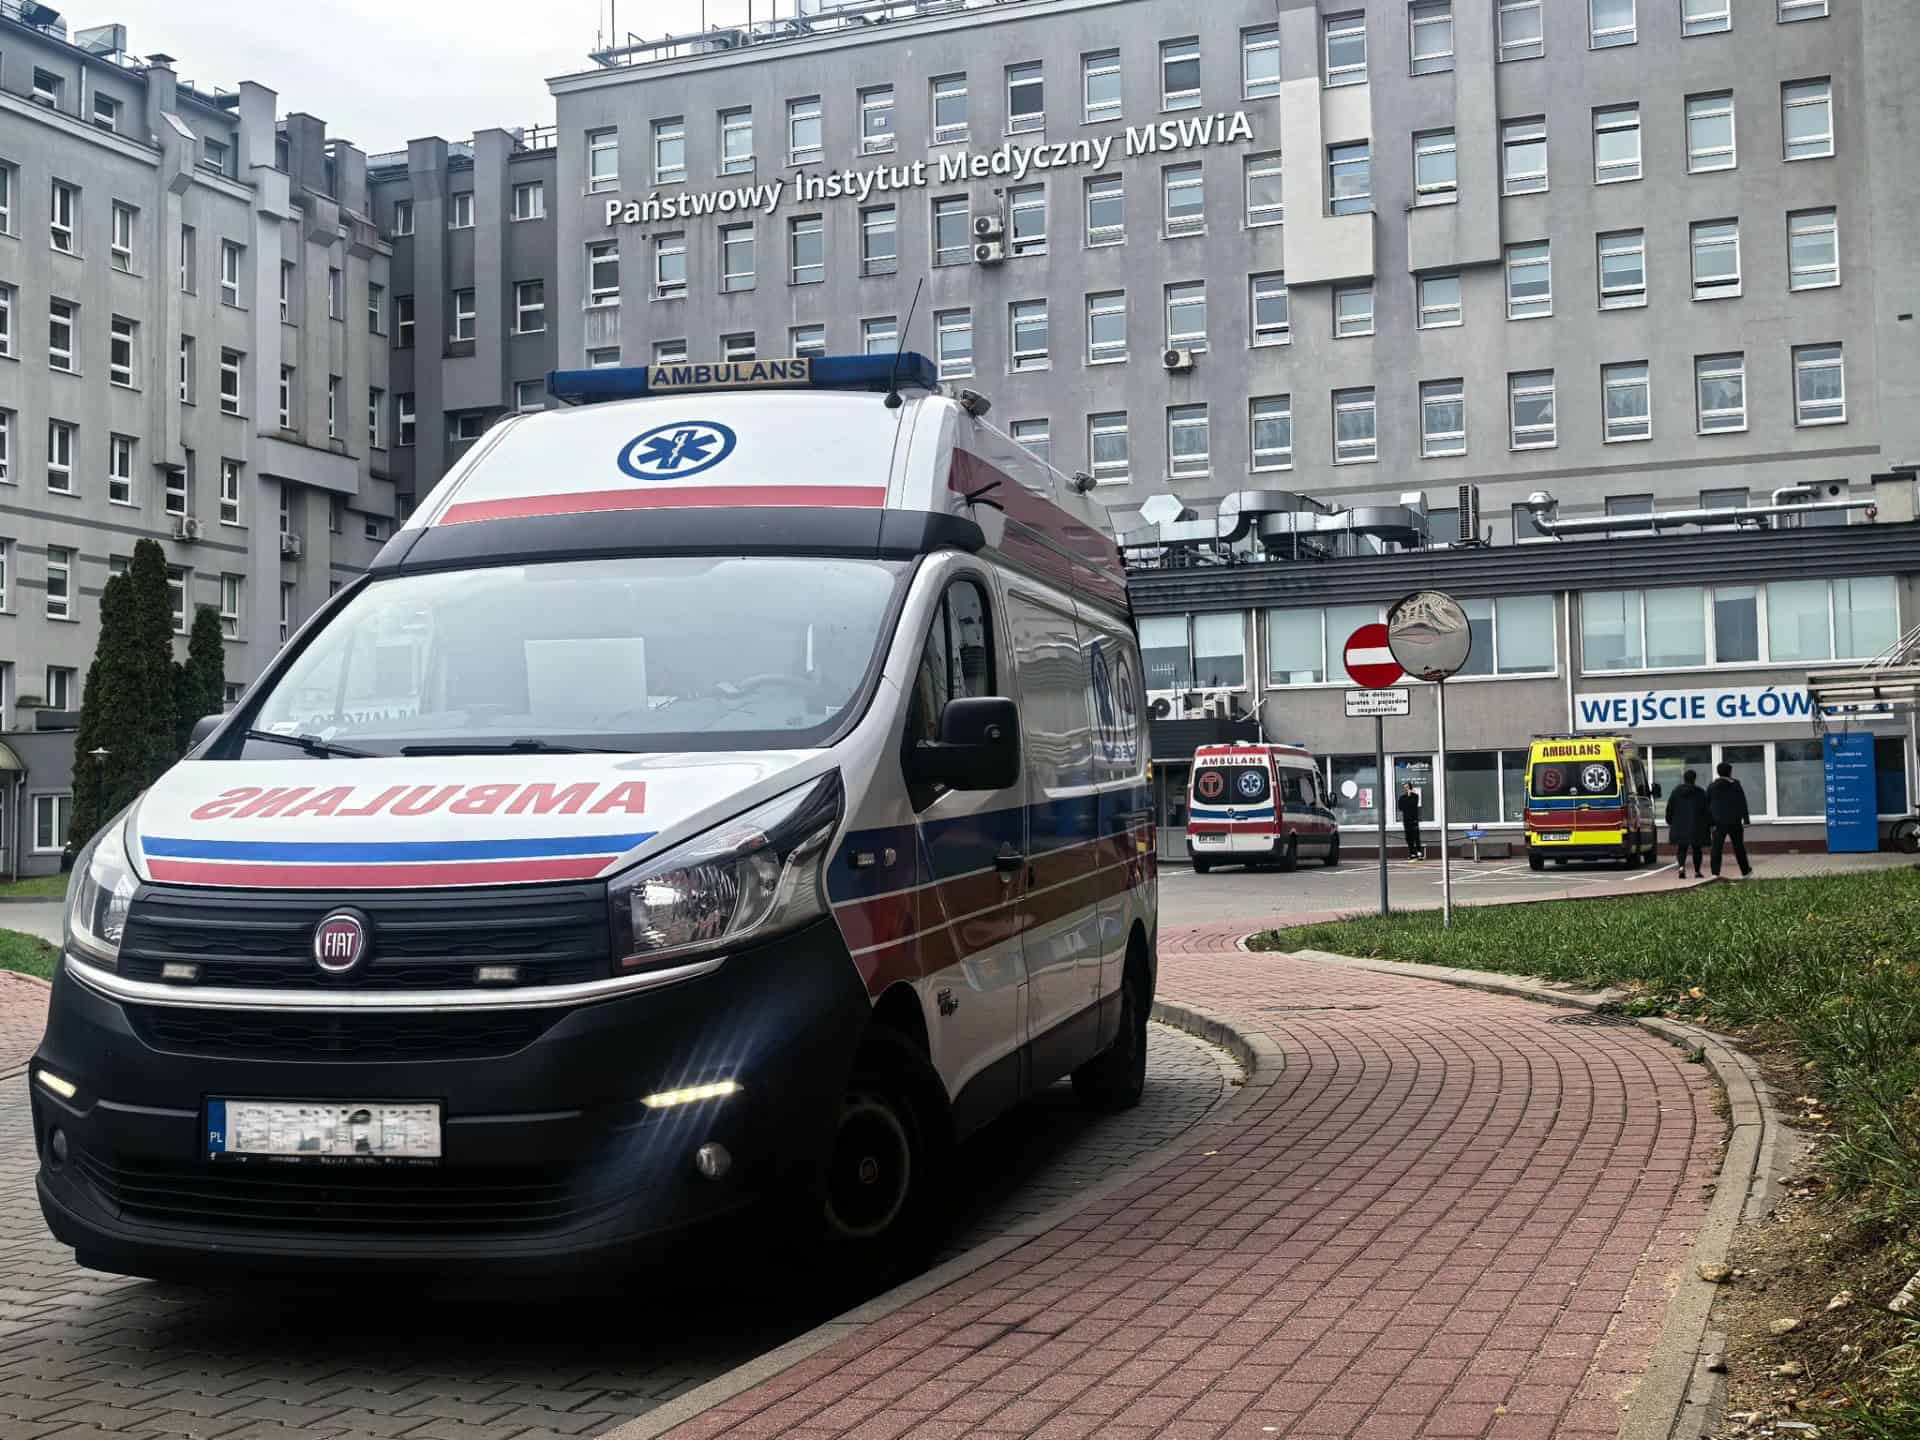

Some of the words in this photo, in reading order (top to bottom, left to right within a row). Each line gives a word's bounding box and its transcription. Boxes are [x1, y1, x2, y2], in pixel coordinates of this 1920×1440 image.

[605, 180, 783, 227] Państwowy
[795, 161, 927, 204] Instytut
[938, 134, 1112, 184] Medyczny
[1125, 110, 1254, 157] MSWiA
[651, 359, 806, 386] AMBULANS
[1581, 691, 1706, 727] WEJŚCIE
[1716, 685, 1889, 720] GŁÓW
[1201, 757, 1263, 766] AMBULANS
[1542, 743, 1601, 757] AMBULANS
[325, 932, 355, 957] FIAT
[210, 1131, 223, 1143] PL
